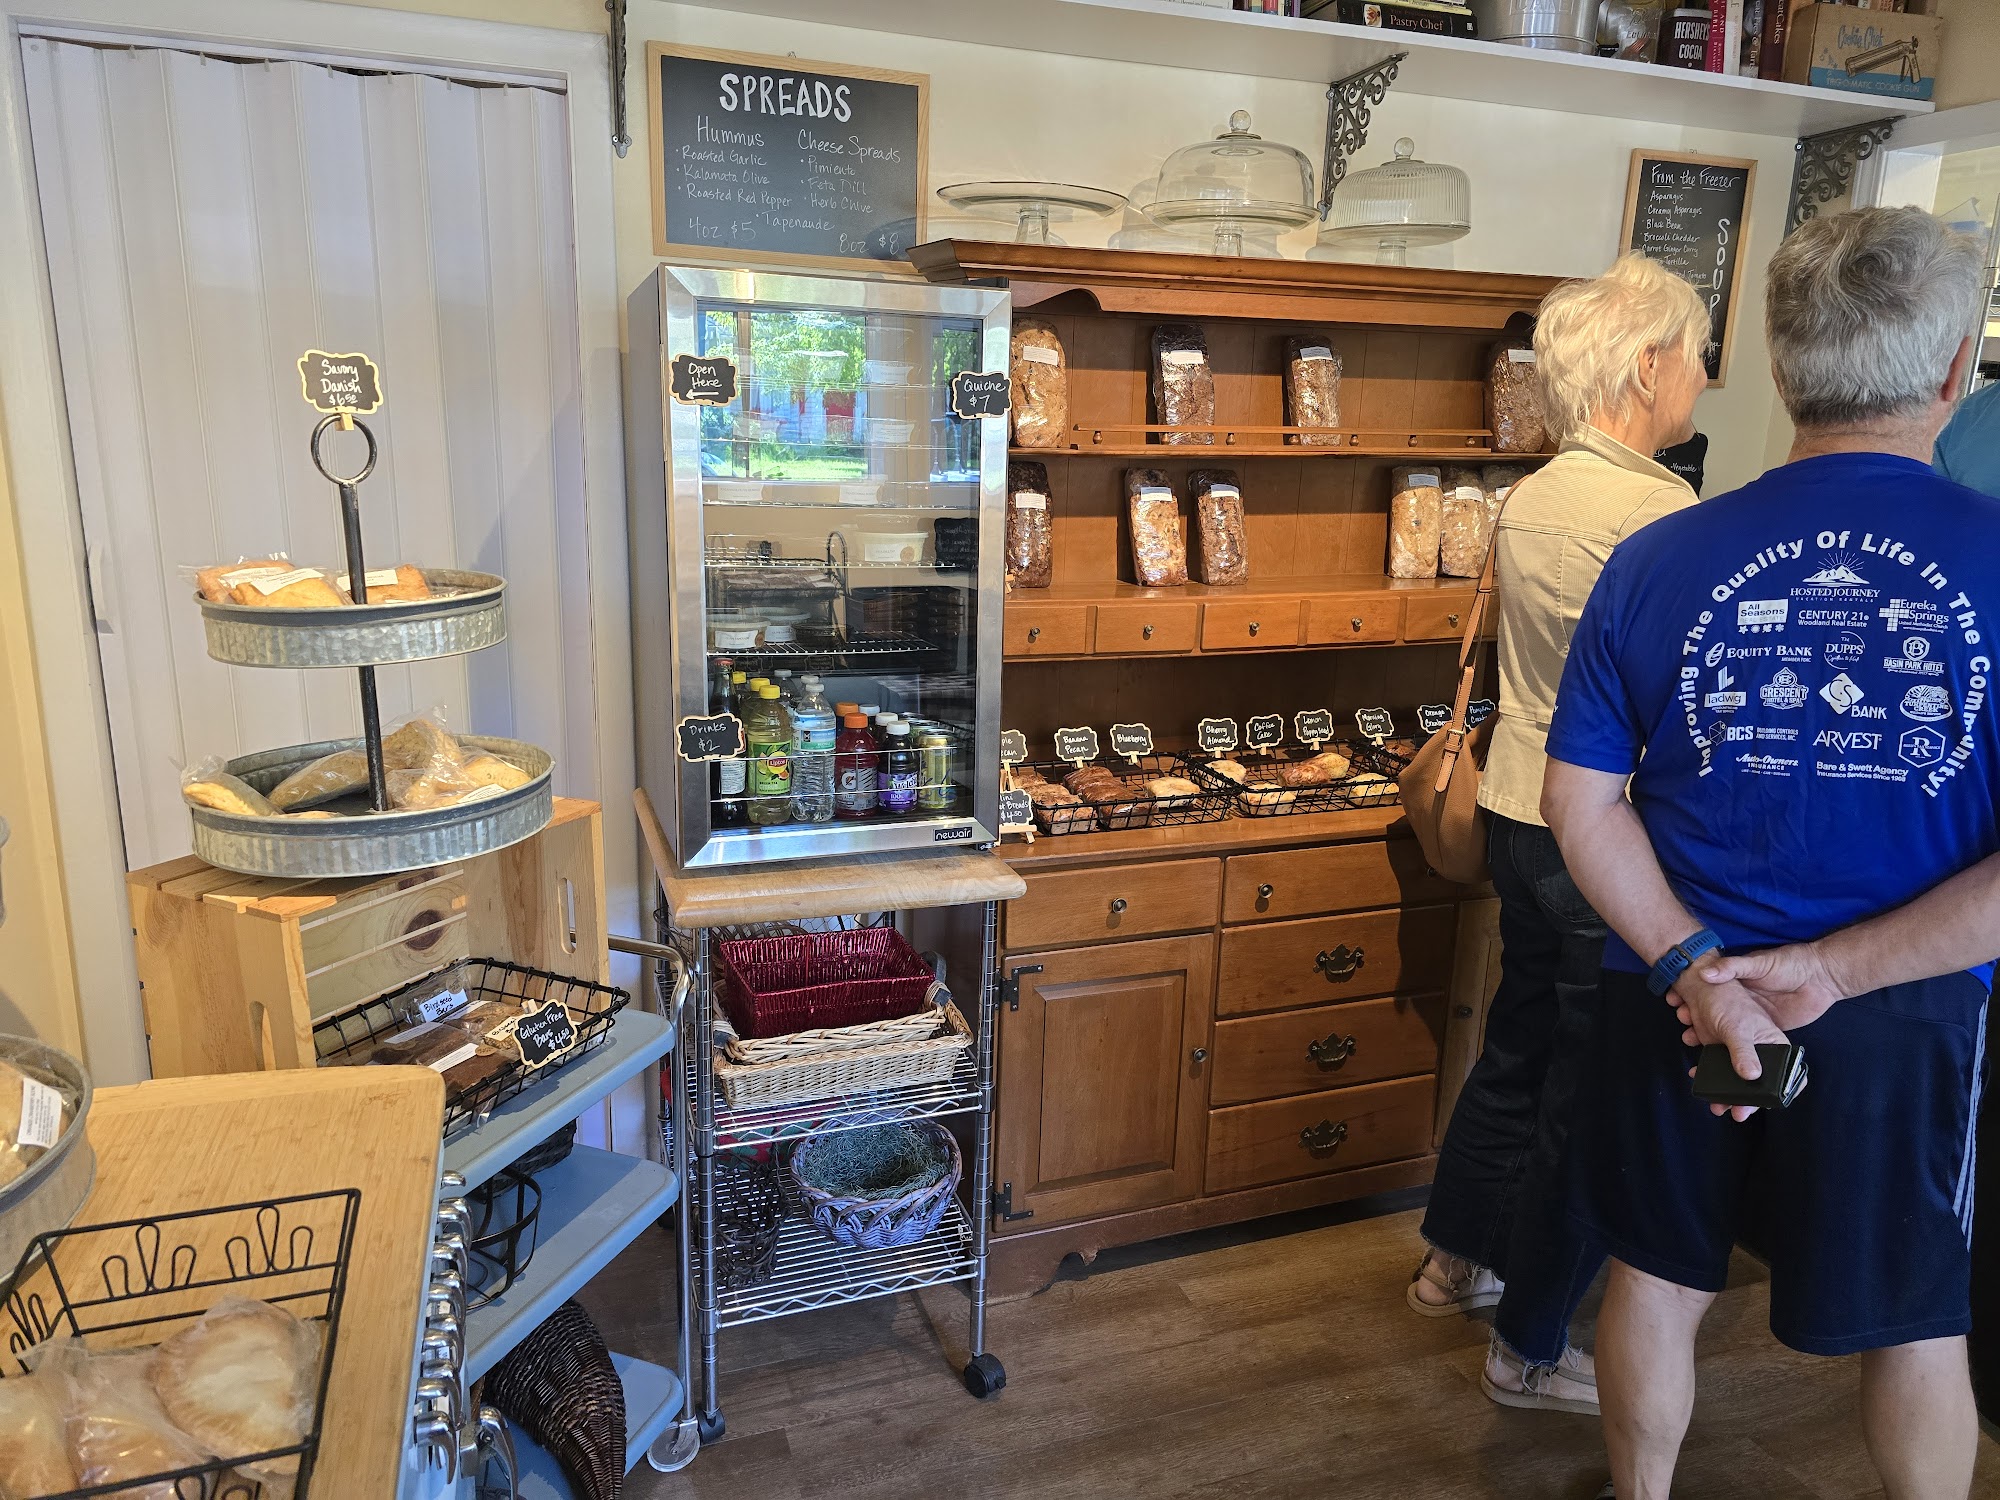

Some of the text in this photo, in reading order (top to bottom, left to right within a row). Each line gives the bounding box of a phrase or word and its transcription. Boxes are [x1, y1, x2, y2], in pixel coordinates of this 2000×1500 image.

[1390, 14, 1443, 31] Pastry Chef
[1837, 25, 1862, 50] Cookie
[1678, 43, 1703, 61] COCOA
[1875, 82, 1901, 92] COOKIE
[1903, 83, 1921, 93] GUN
[719, 72, 852, 123] SPREADS
[696, 115, 765, 148] Hummus
[797, 128, 901, 164] Cheese Spreads
[682, 145, 768, 167] Roasted Garlic
[807, 156, 856, 176] Pimiento
[683, 164, 771, 185] Kalamata Olive
[1651, 163, 1740, 189] From the Freezer
[808, 176, 867, 196] Feta Dill
[686, 184, 793, 211] Roasted Red Pepper
[811, 193, 873, 214] Herb Chive
[1650, 190, 1684, 205] Asparagus
[1648, 204, 1703, 220] Creamy Asparagus
[688, 216, 757, 241] 4oz $5
[1646, 218, 1684, 231] Black Bean
[839, 232, 900, 255] 8oz $8
[1643, 232, 1701, 243] Broccoli Cheddar
[1663, 244, 1682, 257] Ginger
[1708, 218, 1731, 316] SOUP
[321, 359, 360, 383] Savory
[688, 362, 717, 379] Open
[320, 378, 362, 394] Danish
[691, 376, 723, 390] Here
[963, 378, 1007, 393] Quiche
[969, 394, 991, 413] $7
[1816, 530, 1852, 549] Of
[1860, 532, 1917, 567] Life
[1710, 537, 1805, 603] Quality
[1919, 561, 1949, 591] In
[1790, 587, 1881, 598] HOSTED JOURNEY
[1740, 609, 1785, 617] Seasons
[1900, 599, 1937, 611] Eureka
[1798, 609, 1849, 620] CENTURY
[1908, 609, 1950, 625] Springs
[1948, 591, 1981, 646] The
[1831, 619, 1846, 627] Real
[1846, 620, 1868, 628] Estate
[1682, 609, 1714, 656] The
[1726, 645, 1813, 660] EQUITY BANK
[1825, 643, 1864, 655] DUPPS
[1883, 658, 1944, 672] BASIN PARK HOTEL
[1762, 687, 1807, 699] CRESCENT
[1303, 715, 1323, 725] Lemon
[1850, 705, 1888, 720] BANK
[688, 722, 727, 736] Drinks
[1254, 721, 1275, 732] Coffee
[1678, 666, 1714, 778] Improving
[1205, 725, 1228, 737] Cherry
[1257, 731, 1273, 741] Cake
[1727, 725, 1754, 742] BCS
[698, 737, 721, 752] $2
[1062, 735, 1089, 744] Banana
[1206, 735, 1235, 746] Almond
[1812, 729, 1883, 755] ARVEST
[1909, 736, 1932, 758] R
[1000, 749, 1018, 757] ecan
[1064, 744, 1089, 755] Pecan
[1735, 753, 1799, 767] Auto-Owners
[1816, 761, 1838, 771] Bare
[1838, 763, 1846, 772] &
[1873, 764, 1909, 777] Agency
[1816, 770, 1847, 778] Insurance
[1006, 800, 1029, 810] Breads
[935, 828, 972, 841] newair
[519, 1020, 548, 1040] Gluten
[545, 1007, 565, 1024] Free
[533, 1028, 554, 1048] Bars
